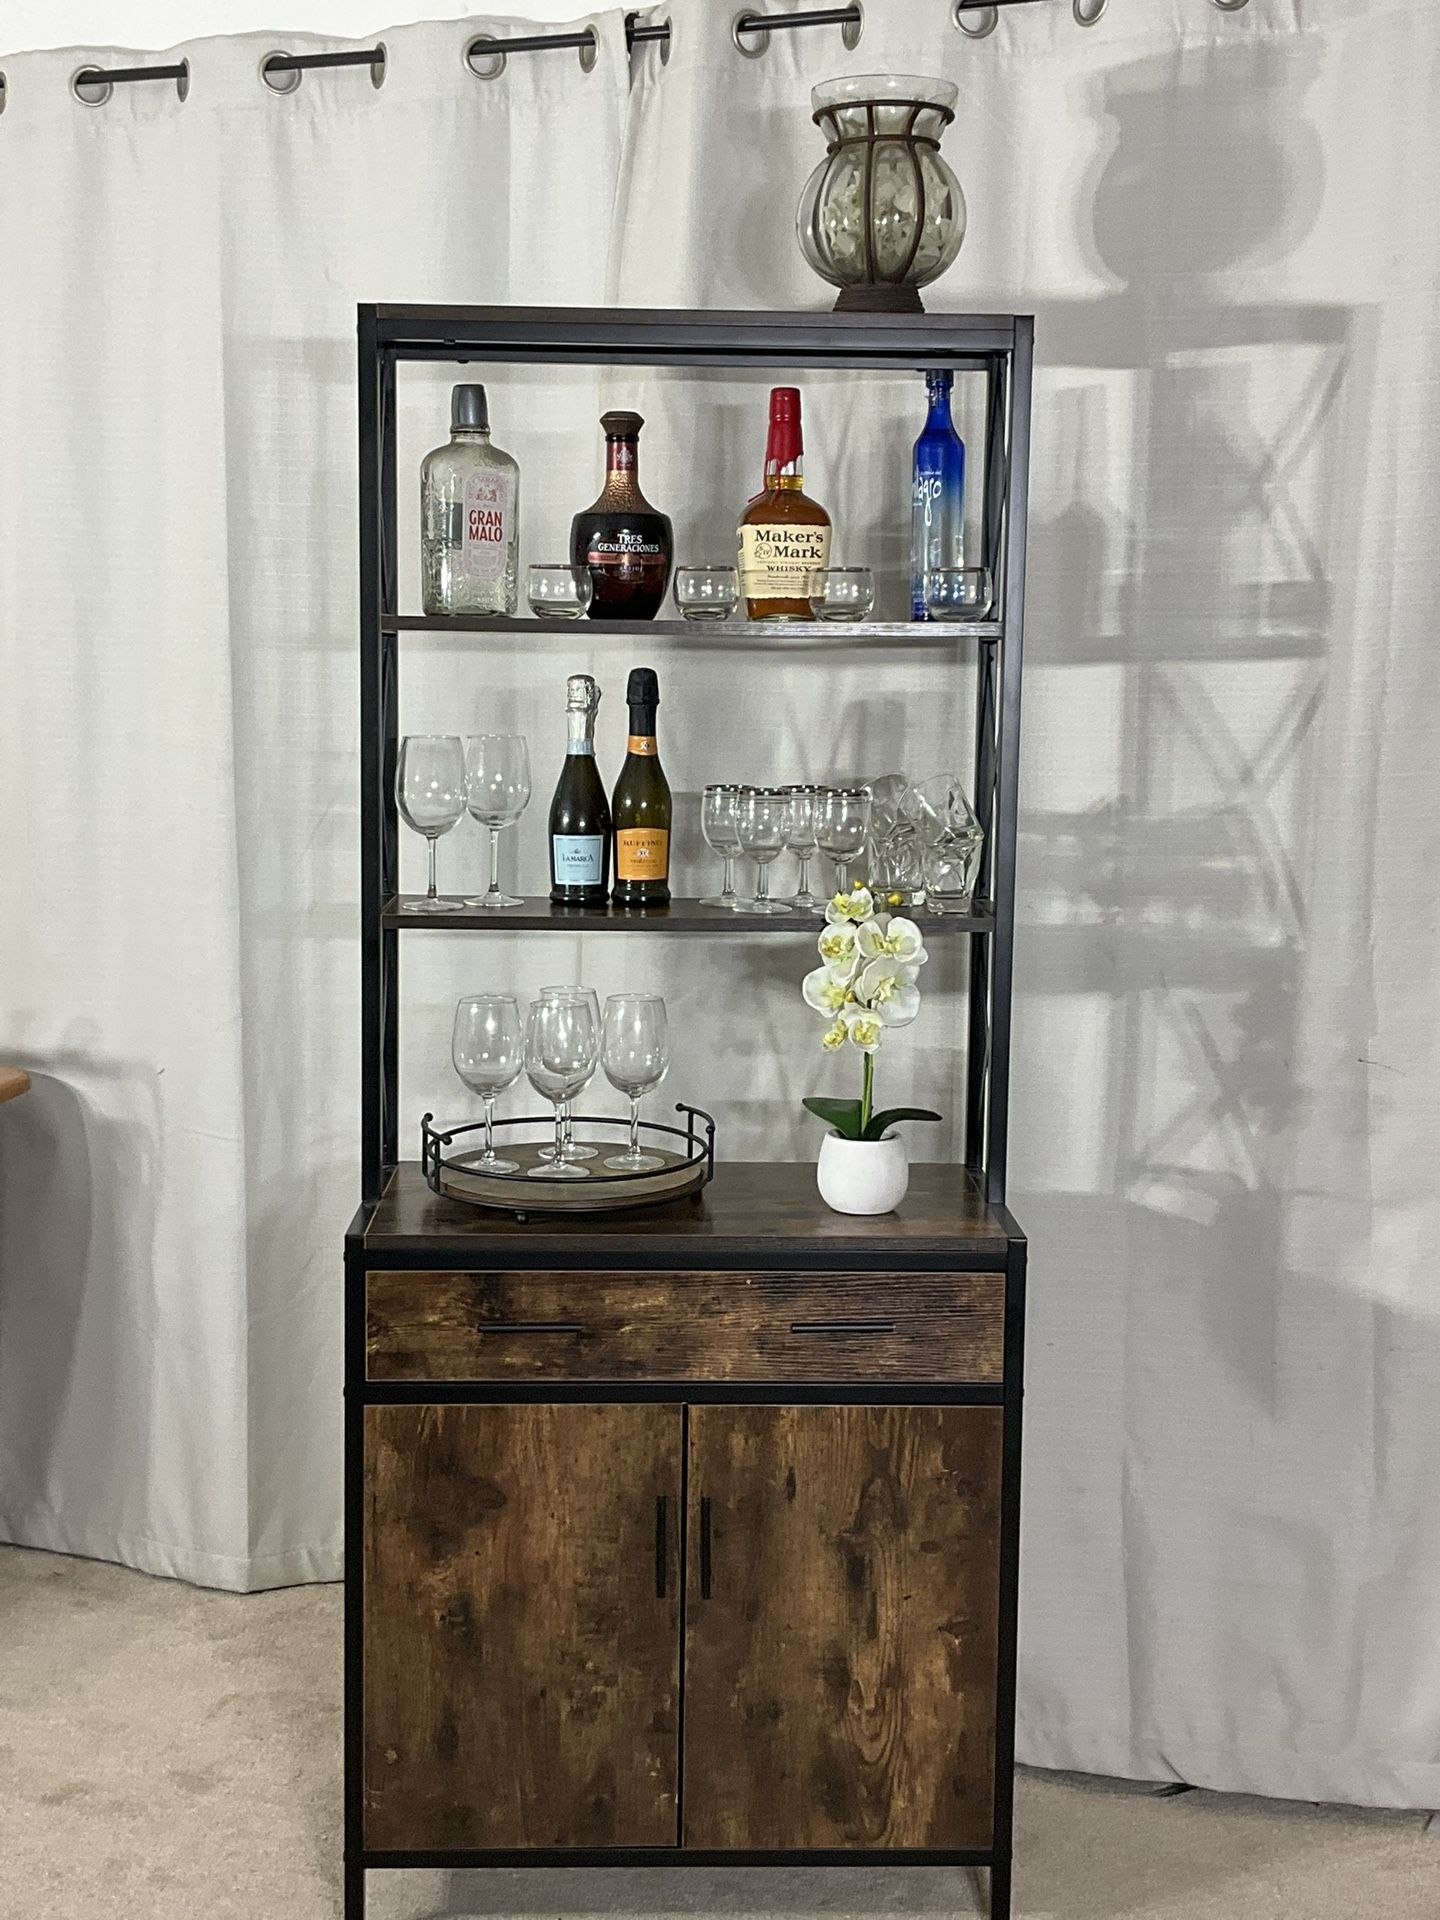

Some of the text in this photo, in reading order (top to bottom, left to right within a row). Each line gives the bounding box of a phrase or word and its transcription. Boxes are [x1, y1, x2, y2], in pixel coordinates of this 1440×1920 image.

[468, 509, 503, 527] GRAN
[468, 525, 503, 542] MALO
[617, 533, 643, 544] TRES
[754, 529, 824, 543] Maker's
[597, 542, 660, 553] GENERACIONES
[772, 545, 823, 559] Mark
[766, 564, 812, 572] WHISKY
